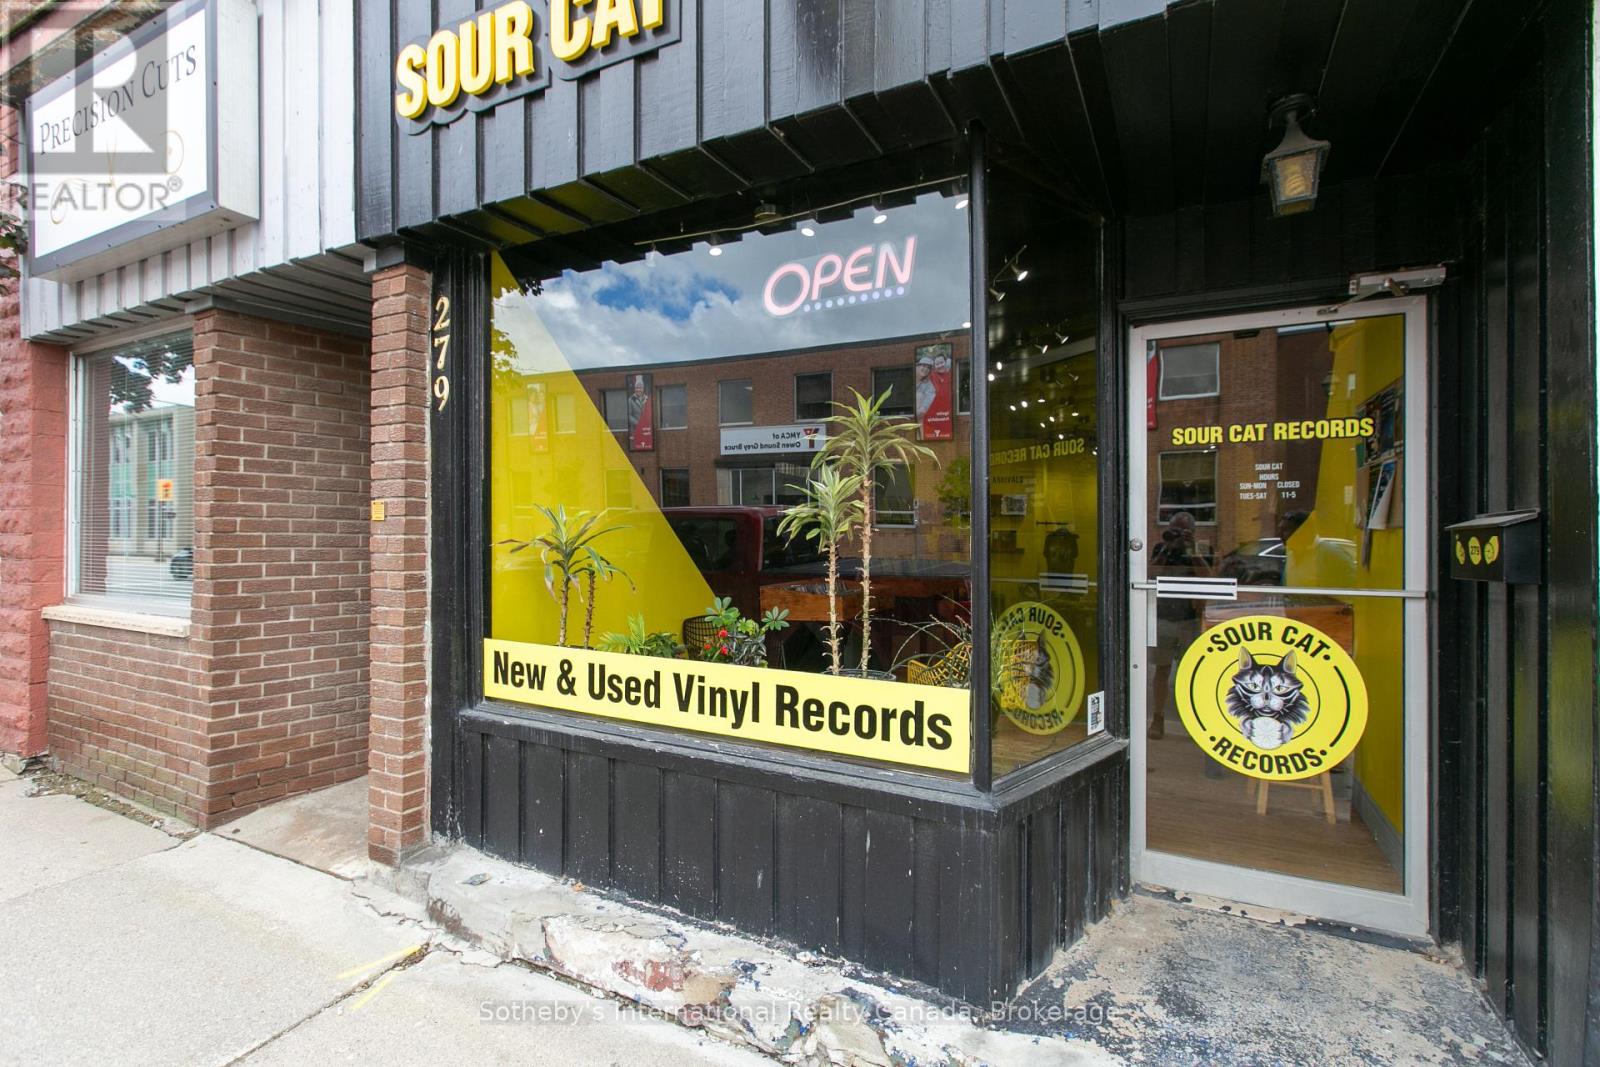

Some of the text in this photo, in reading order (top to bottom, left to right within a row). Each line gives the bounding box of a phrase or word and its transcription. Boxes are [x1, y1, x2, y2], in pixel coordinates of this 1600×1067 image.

[396, 0, 535, 119] SOUR
[763, 234, 918, 317] OPEN
[433, 296, 450, 411] 279
[1172, 417, 1374, 446] SOUR CAT RECORDS
[1239, 491, 1297, 500] TUES-SAT 11-5
[1258, 473, 1279, 481] HOURS
[1276, 481, 1300, 489] CLOSED
[1211, 621, 1331, 660] SOUR CAT
[493, 650, 953, 751] New & Used Vinyl Records
[1212, 736, 1324, 775] RECORDS
